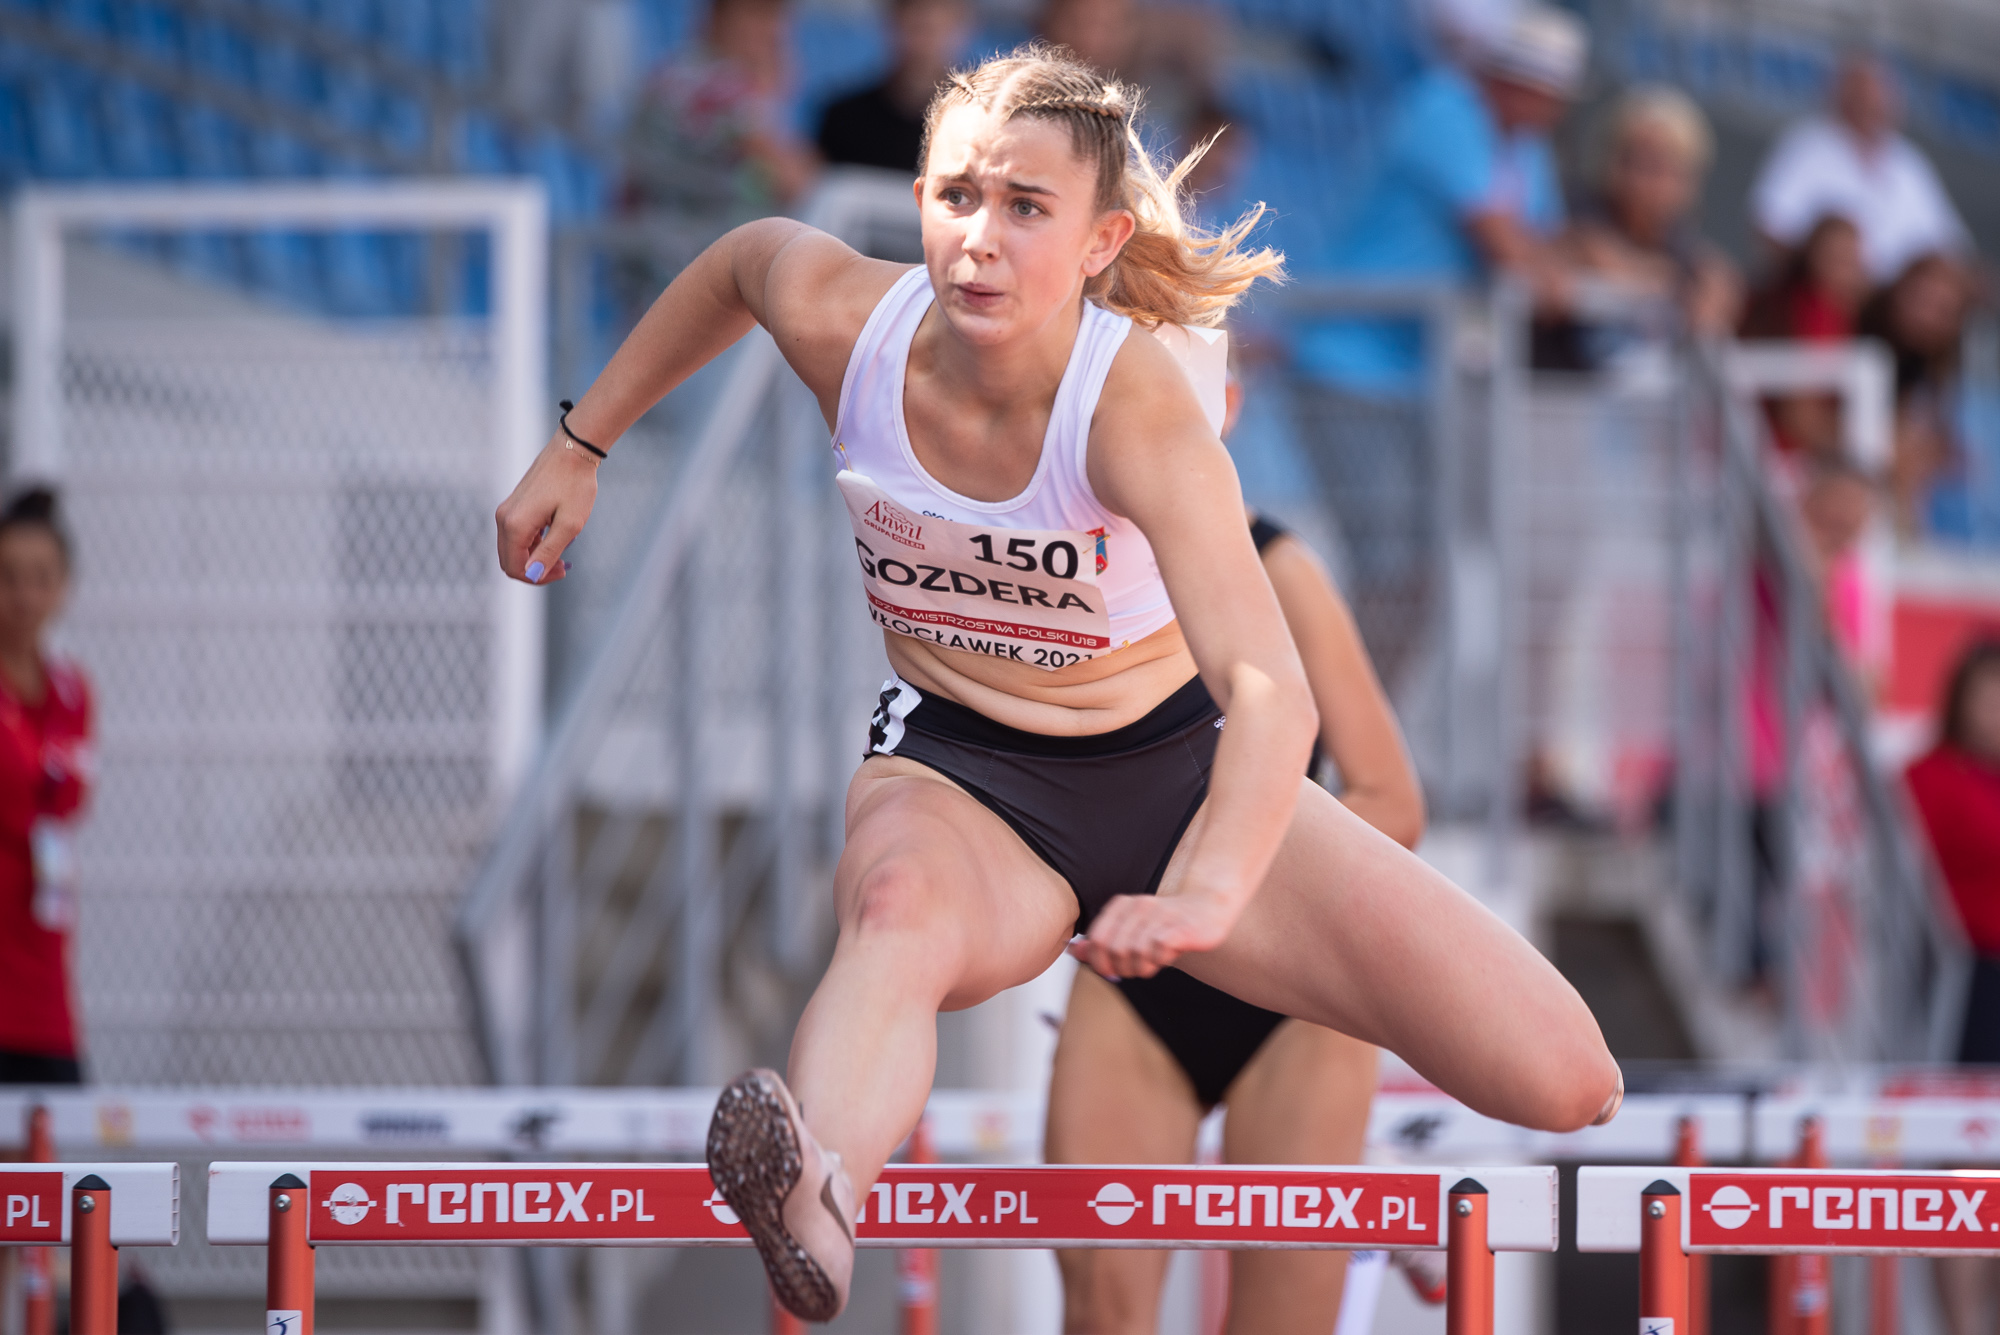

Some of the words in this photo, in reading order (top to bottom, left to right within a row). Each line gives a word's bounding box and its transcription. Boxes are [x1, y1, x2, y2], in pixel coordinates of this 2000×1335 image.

[864, 500, 922, 540] Anwil
[864, 519, 891, 537] GRUPA
[893, 534, 923, 549] ORLEN
[855, 536, 1095, 613] GOZDERA
[969, 534, 1079, 580] 150
[875, 599, 909, 617] PZLA
[912, 612, 1015, 635] MISTRZOSTWA
[1018, 627, 1069, 642] POLSKI
[1071, 635, 1097, 647] U18
